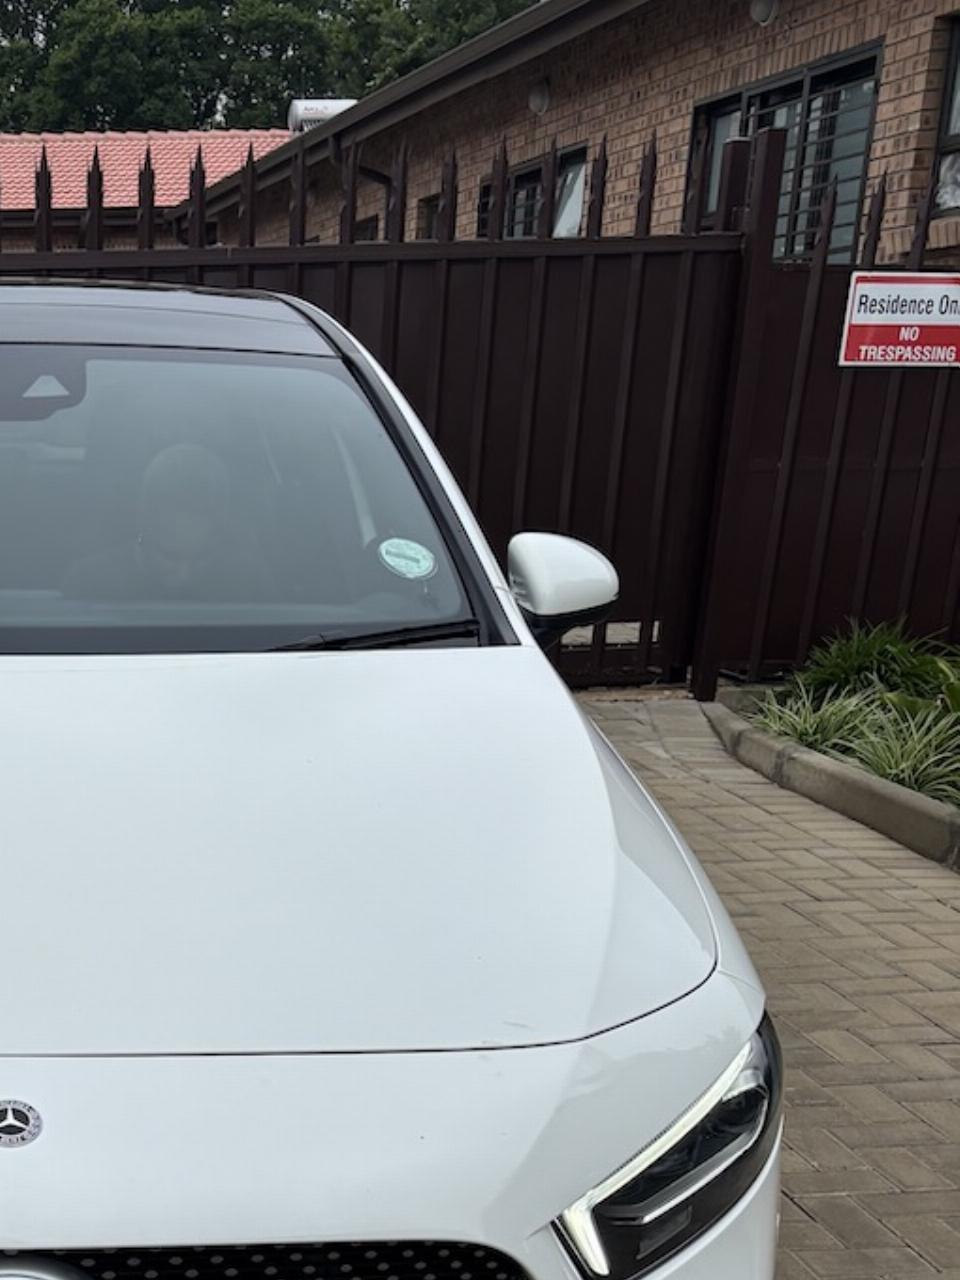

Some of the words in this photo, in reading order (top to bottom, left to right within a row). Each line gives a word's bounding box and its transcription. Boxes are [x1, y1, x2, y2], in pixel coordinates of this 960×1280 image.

[857, 294, 934, 315] Residence
[938, 294, 960, 315] On
[899, 326, 920, 341] NO
[859, 345, 957, 361] TRESPASSING
